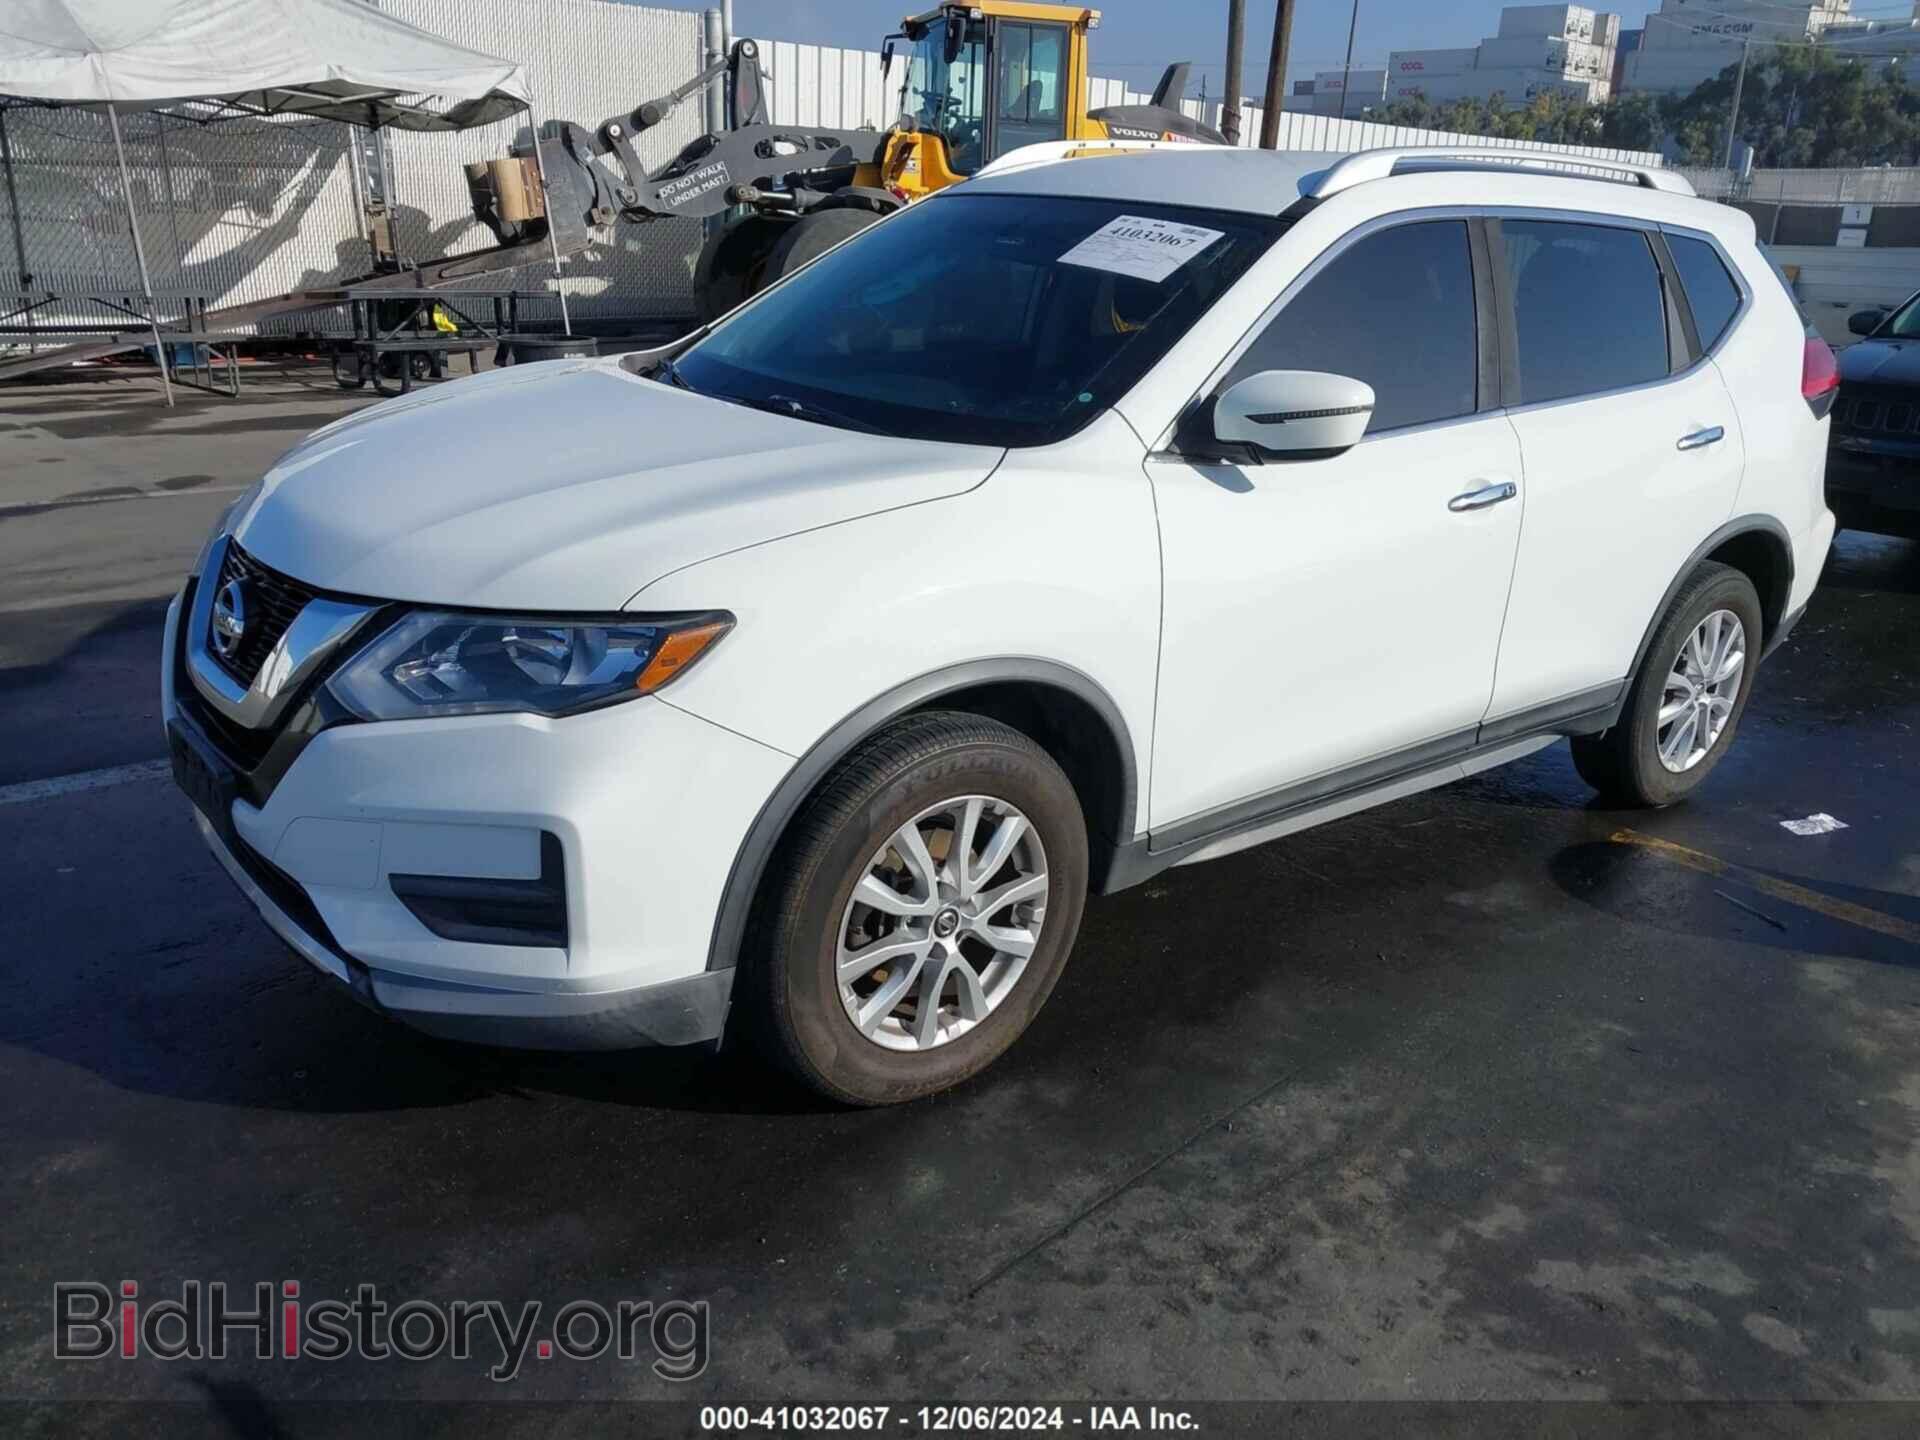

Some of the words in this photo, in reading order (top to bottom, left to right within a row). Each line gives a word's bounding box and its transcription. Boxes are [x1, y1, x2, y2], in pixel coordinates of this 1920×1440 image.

[1111, 127, 1158, 139] VOLVO
[660, 185, 676, 198] DO
[676, 174, 696, 190] NOT
[697, 161, 726, 179] WALK
[670, 186, 702, 206] UNDER
[701, 175, 725, 192] MAST
[1110, 226, 1198, 249] 41032067
